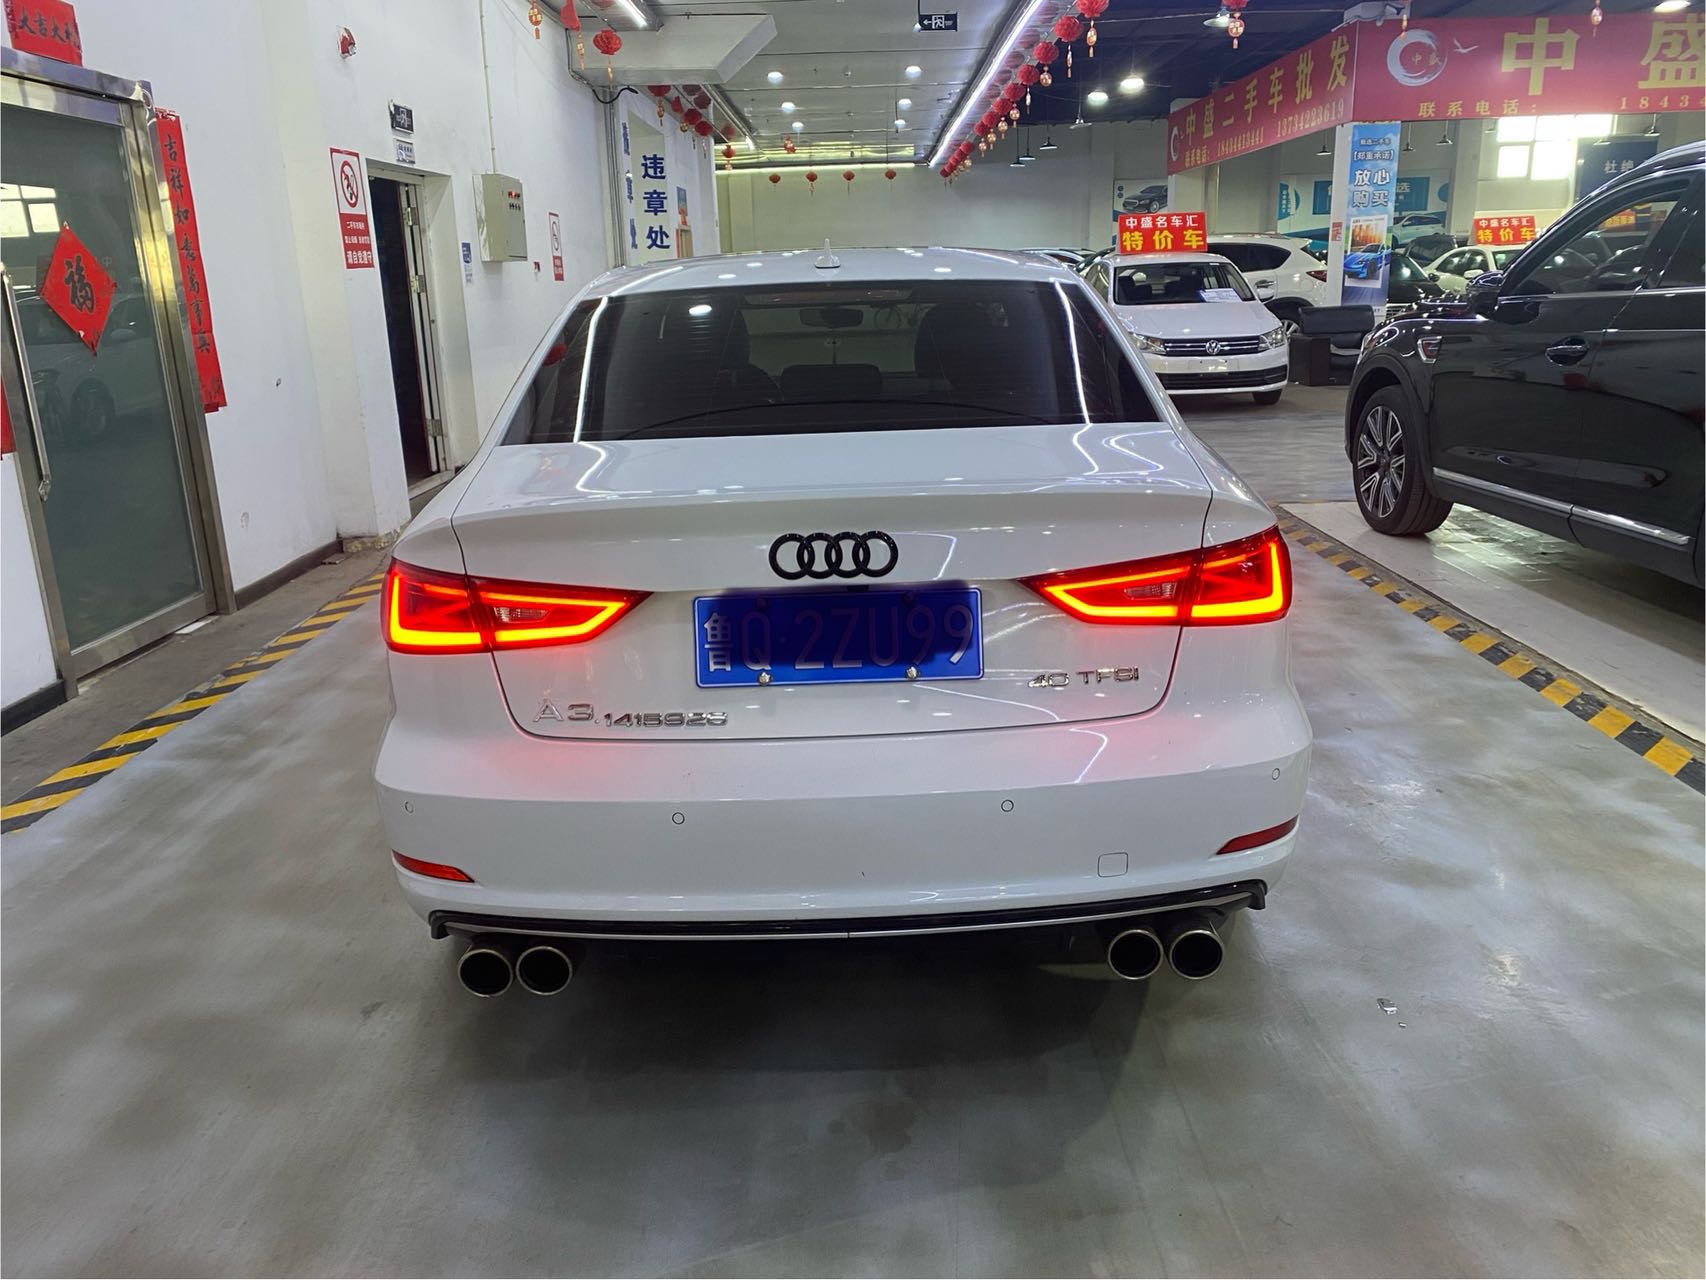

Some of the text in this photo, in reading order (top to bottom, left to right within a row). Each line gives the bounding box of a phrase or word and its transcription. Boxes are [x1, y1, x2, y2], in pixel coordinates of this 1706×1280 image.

[1184, 35, 1351, 145] 中盛二手车批发
[1277, 99, 1344, 138] 13734223619
[1354, 169, 1390, 187] 放心
[641, 154, 671, 250] 违章处
[1352, 191, 1389, 207] 购买
[1125, 215, 1199, 229] 中盛名车汇
[1479, 217, 1532, 228] 中盛名车汇
[1122, 229, 1205, 251] 特价车
[1477, 227, 1536, 242] 特价车
[64, 255, 95, 314] 福
[1028, 666, 1139, 688] 40 TFSI
